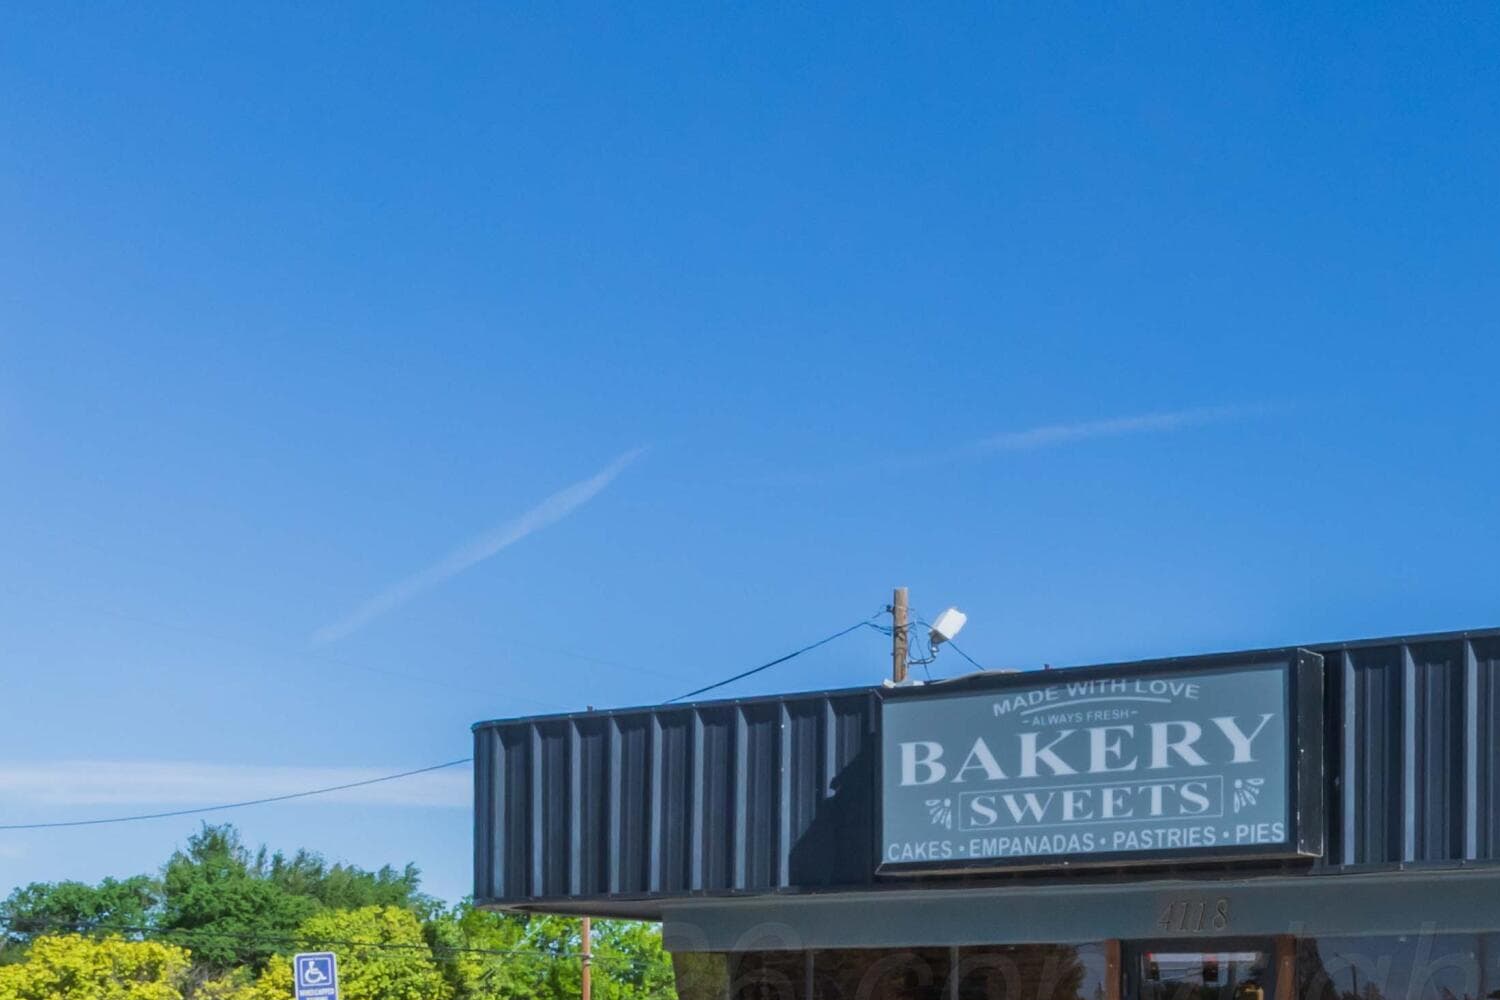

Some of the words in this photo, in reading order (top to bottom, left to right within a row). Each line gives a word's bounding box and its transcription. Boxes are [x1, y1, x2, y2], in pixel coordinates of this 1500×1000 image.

[993, 687, 1060, 717] MADE
[1066, 679, 1127, 697] WITH
[1135, 679, 1201, 700] LOVE
[1032, 713, 1083, 727] ALWAYS
[1086, 708, 1129, 722] FRESH
[898, 713, 1275, 787] BAKERY
[970, 781, 1211, 827] SWEETS
[888, 840, 953, 861] CAKES
[969, 832, 1095, 857] EMPANADAS
[1113, 826, 1217, 850] PASTRIES
[1236, 822, 1285, 843] PIES
[1158, 897, 1230, 934] 4118
